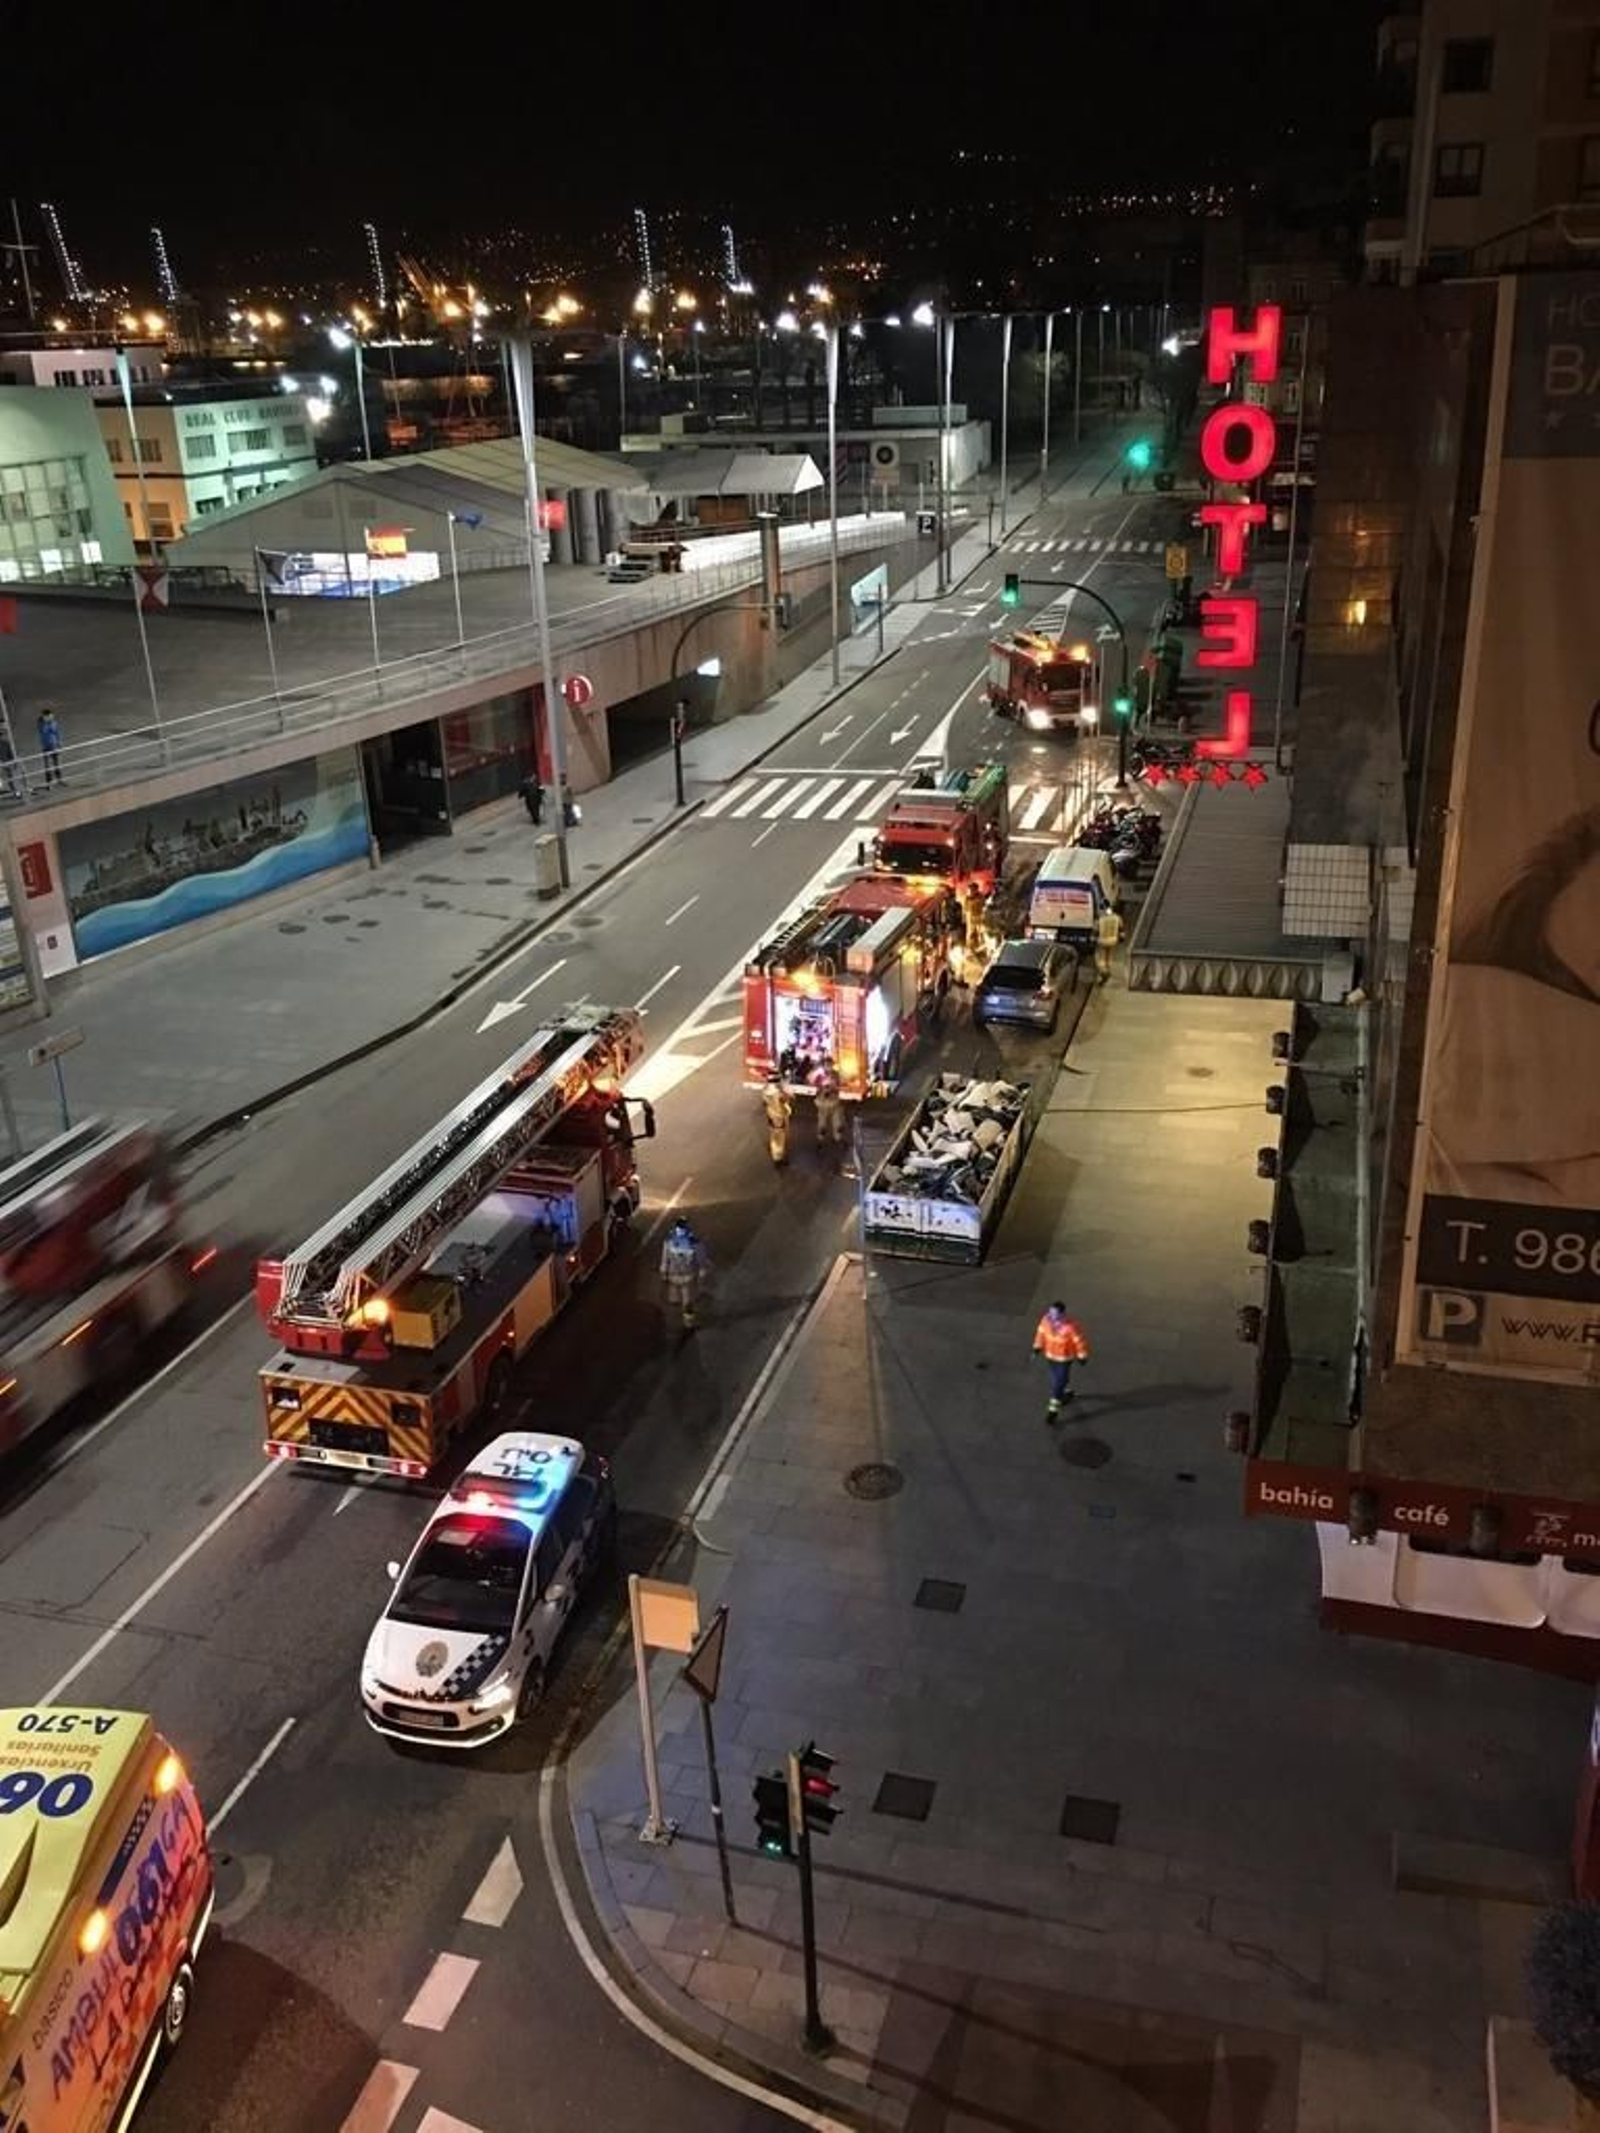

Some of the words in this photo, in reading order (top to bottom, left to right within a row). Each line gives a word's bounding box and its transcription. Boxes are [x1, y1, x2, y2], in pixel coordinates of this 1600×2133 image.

[1447, 1220, 1488, 1264] T.
[1428, 1292, 1477, 1338] P
[1394, 1505, 1450, 1527] café
[17, 1713, 119, 1735] A-570
[7, 1741, 102, 1758] Sanitarias
